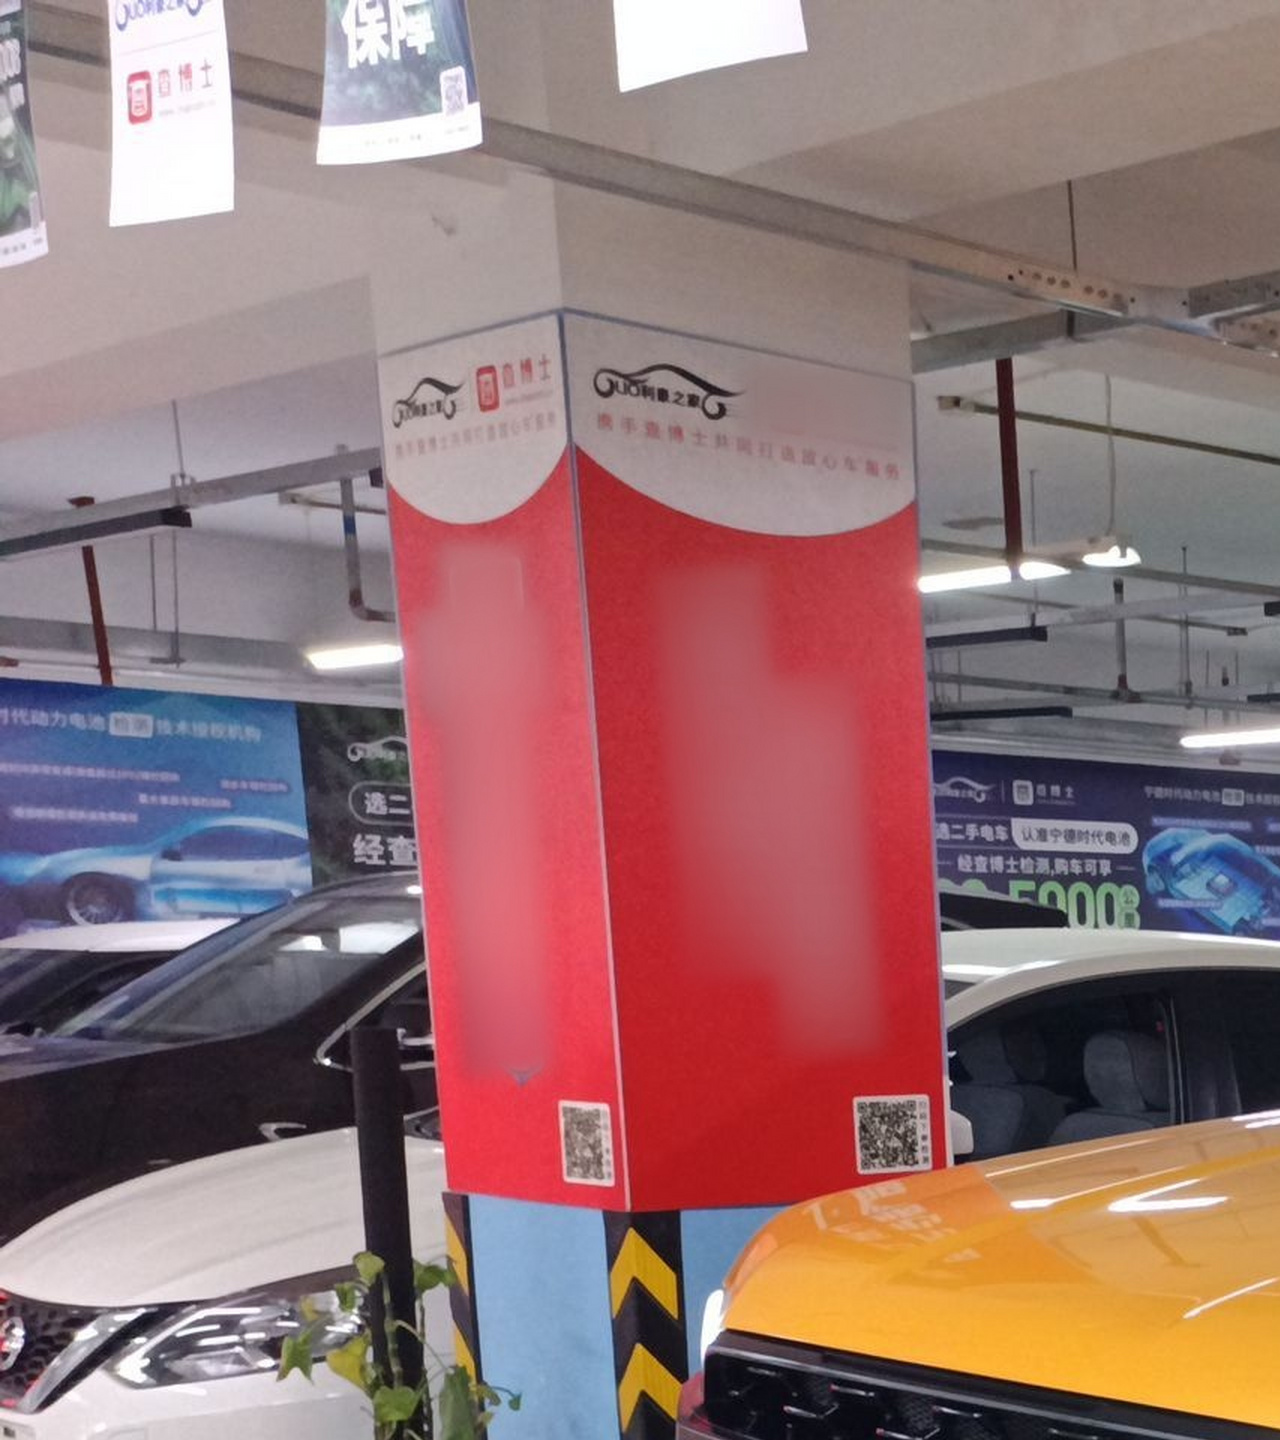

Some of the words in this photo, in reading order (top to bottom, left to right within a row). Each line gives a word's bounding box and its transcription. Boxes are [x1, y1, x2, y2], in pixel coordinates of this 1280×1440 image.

[1021, 826, 1132, 847] 认准宁德时代电池
